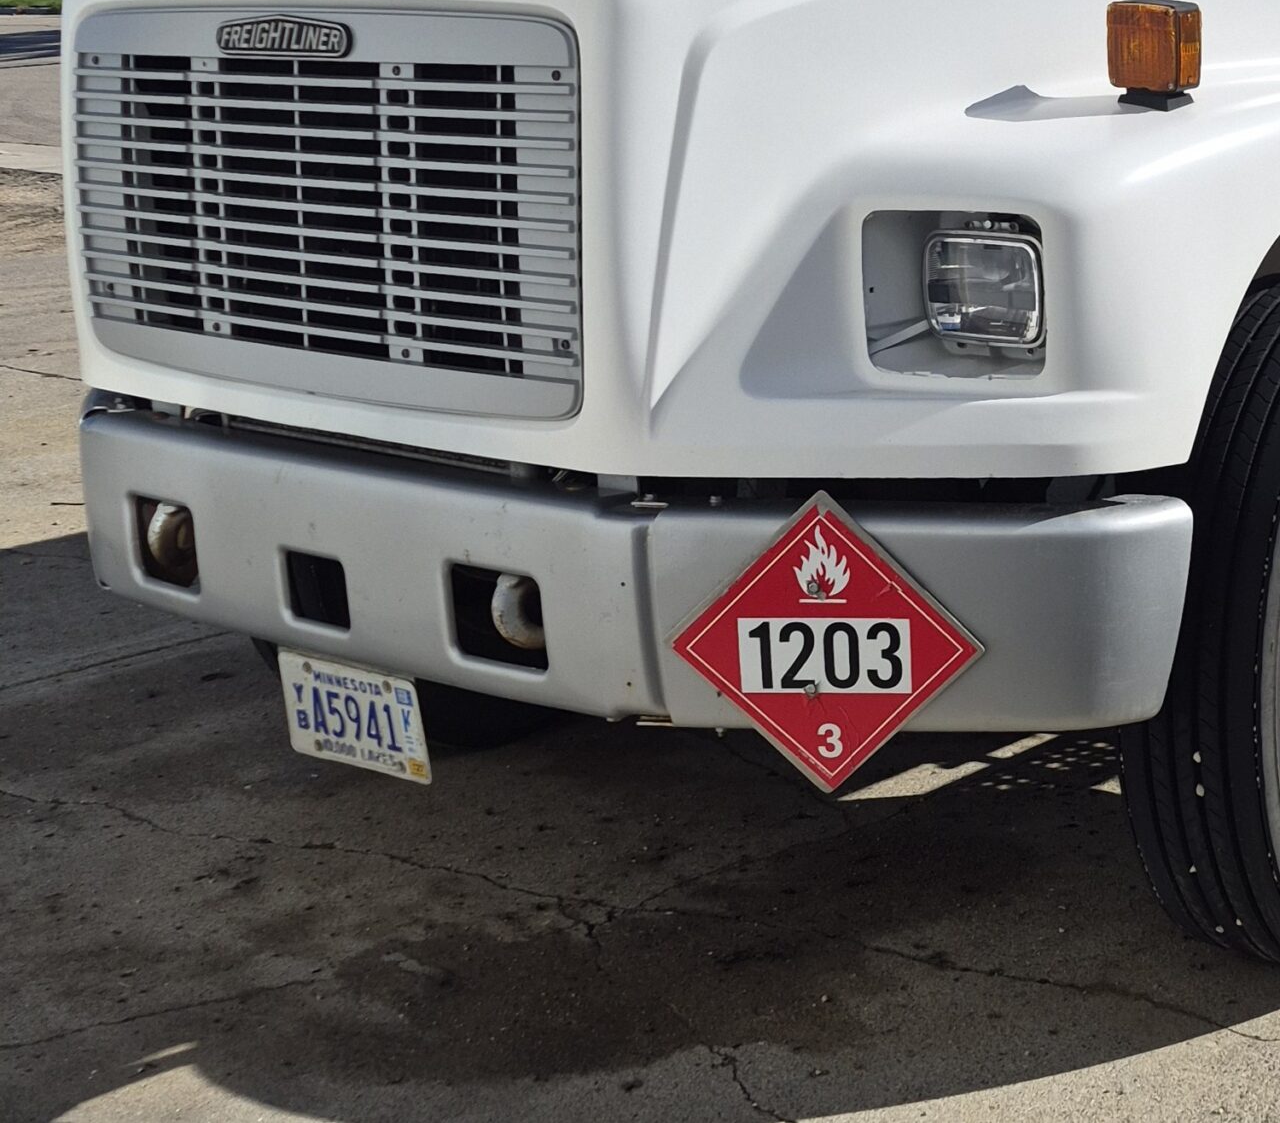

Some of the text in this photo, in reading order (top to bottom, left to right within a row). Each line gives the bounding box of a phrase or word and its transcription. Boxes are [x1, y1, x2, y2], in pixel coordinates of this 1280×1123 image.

[219, 21, 341, 51] FREIGHTLINER
[748, 621, 903, 690] 1203
[313, 670, 383, 697] MINNESOTA
[312, 686, 403, 752] A5941
[816, 723, 843, 758] 3
